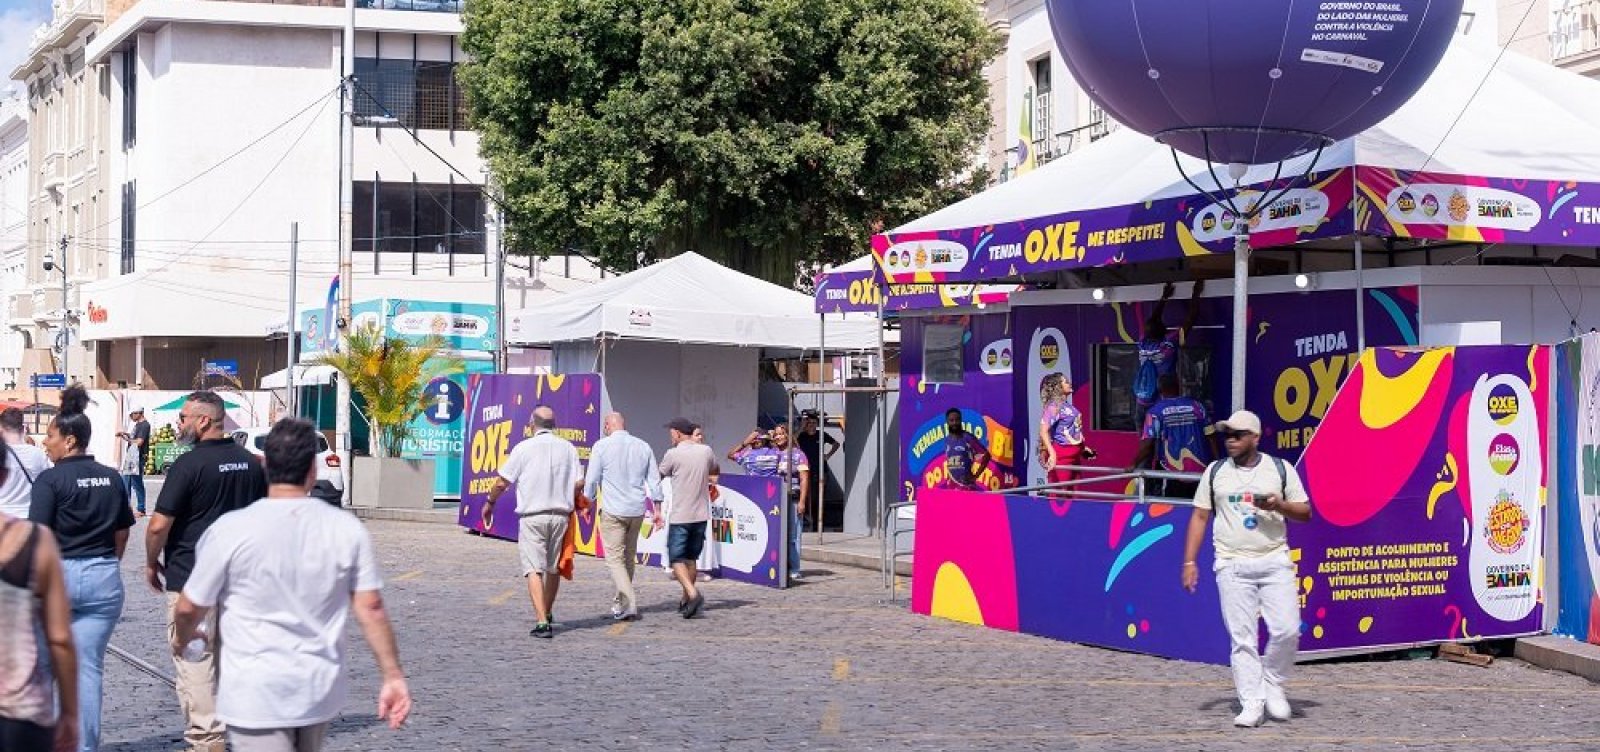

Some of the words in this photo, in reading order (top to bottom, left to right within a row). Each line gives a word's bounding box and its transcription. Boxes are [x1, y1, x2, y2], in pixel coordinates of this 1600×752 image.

[1319, 2, 1363, 10] GOVERNO
[1362, 2, 1377, 10] DO
[1317, 12, 1331, 21] DO
[1330, 12, 1356, 20] LADO
[1355, 12, 1373, 20] DAS
[1314, 23, 1348, 31] CONTRA
[1347, 23, 1356, 31] A
[1311, 33, 1325, 41] NO
[1269, 203, 1302, 220] BAHIA
[1477, 205, 1513, 218] BAHIA
[988, 243, 1022, 260] TENDA
[1024, 221, 1086, 263] OXE,
[1087, 231, 1105, 247] ME
[1108, 222, 1166, 245] RESPEITE!
[1295, 330, 1348, 357] TENDA
[1273, 352, 1359, 423] OX
[1488, 395, 1517, 410] OXE
[482, 403, 504, 422] TENDA
[912, 424, 945, 459] VENHA
[1276, 428, 1300, 450] ME
[218, 462, 249, 473] DETRAN
[77, 477, 111, 488] DETRAN
[925, 466, 943, 489] DO
[1326, 547, 1360, 558] PONTO
[1361, 545, 1374, 556] DE
[1375, 543, 1443, 556] ACOLHIMENTO
[1443, 542, 1449, 552] E
[1318, 558, 1380, 573] ASSISTÊNCIA
[1381, 558, 1407, 570] PARA
[1409, 556, 1458, 569] MULHERES
[1328, 573, 1369, 587] VÍTIMAS
[1370, 573, 1382, 585] DE
[1383, 569, 1433, 583] VIOLÊNCIA
[1434, 570, 1449, 581] OU
[1486, 572, 1531, 589] BAHIA
[1332, 584, 1409, 601] IMPORTUNAÇÃO
[1410, 584, 1446, 596] SEXUAL
